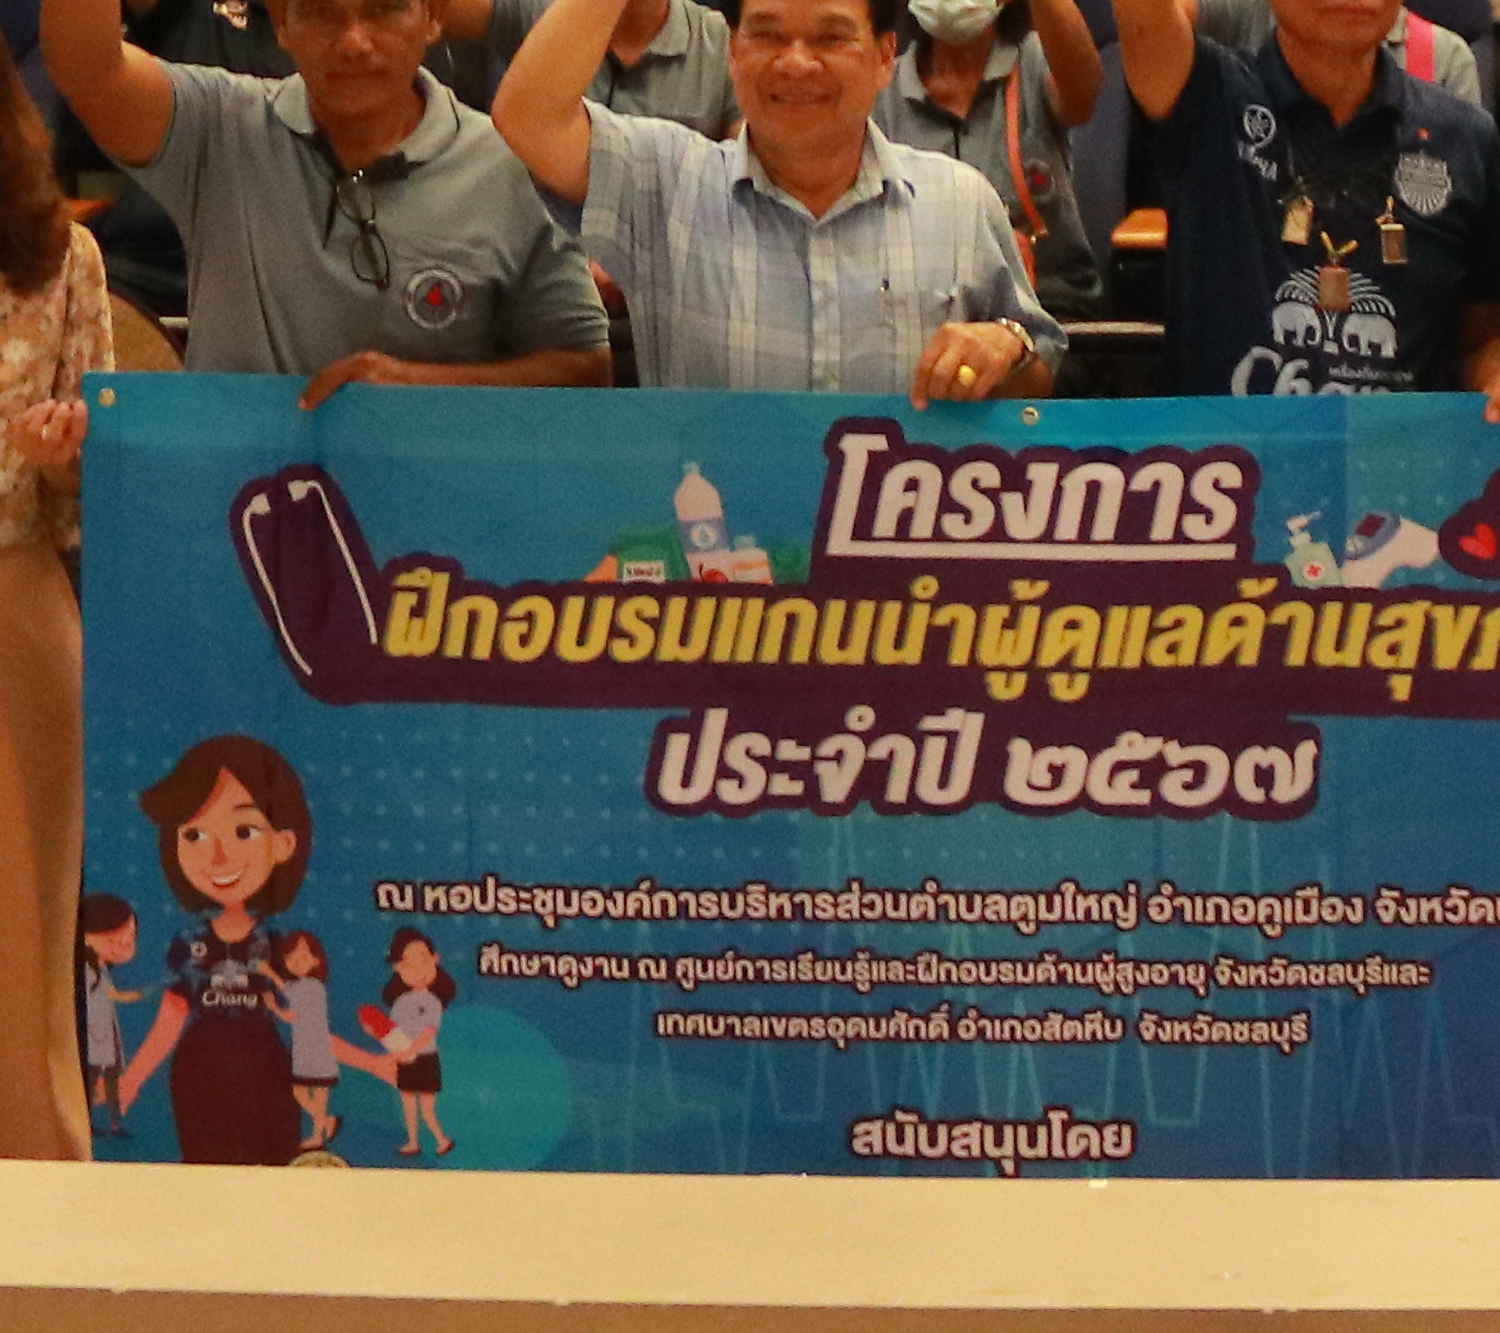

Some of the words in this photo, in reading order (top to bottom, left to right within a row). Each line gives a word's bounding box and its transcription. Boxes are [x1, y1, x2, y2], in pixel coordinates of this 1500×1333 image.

[826, 434, 1244, 561] โครงการ
[657, 705, 986, 806] ประจำปี
[1003, 731, 1318, 807] ๒๕๖๗
[376, 880, 414, 912] ณ
[424, 876, 1138, 935] หอประชุมองค์การบริหารส่วนตำบลตูมใหญ่
[1147, 881, 1364, 938] อำเภอคูเมือง
[479, 943, 630, 989] ศึกษาดูงาน
[637, 958, 667, 981] ณ
[675, 949, 1206, 996] ศูนย์การเรียนรู้และฝึกอบรมด้านผู้สูงอายุ
[1214, 955, 1432, 995] จังหวัดชลบุรีและ
[656, 1000, 950, 1049] เทศบาลเขตรอุดมศักดิ์
[957, 1007, 1124, 1043] อำเภอสัตหีบ
[1138, 1011, 1310, 1054] จังหวัดชลบุรี
[851, 1109, 1134, 1175] สนับสนุนโดย
